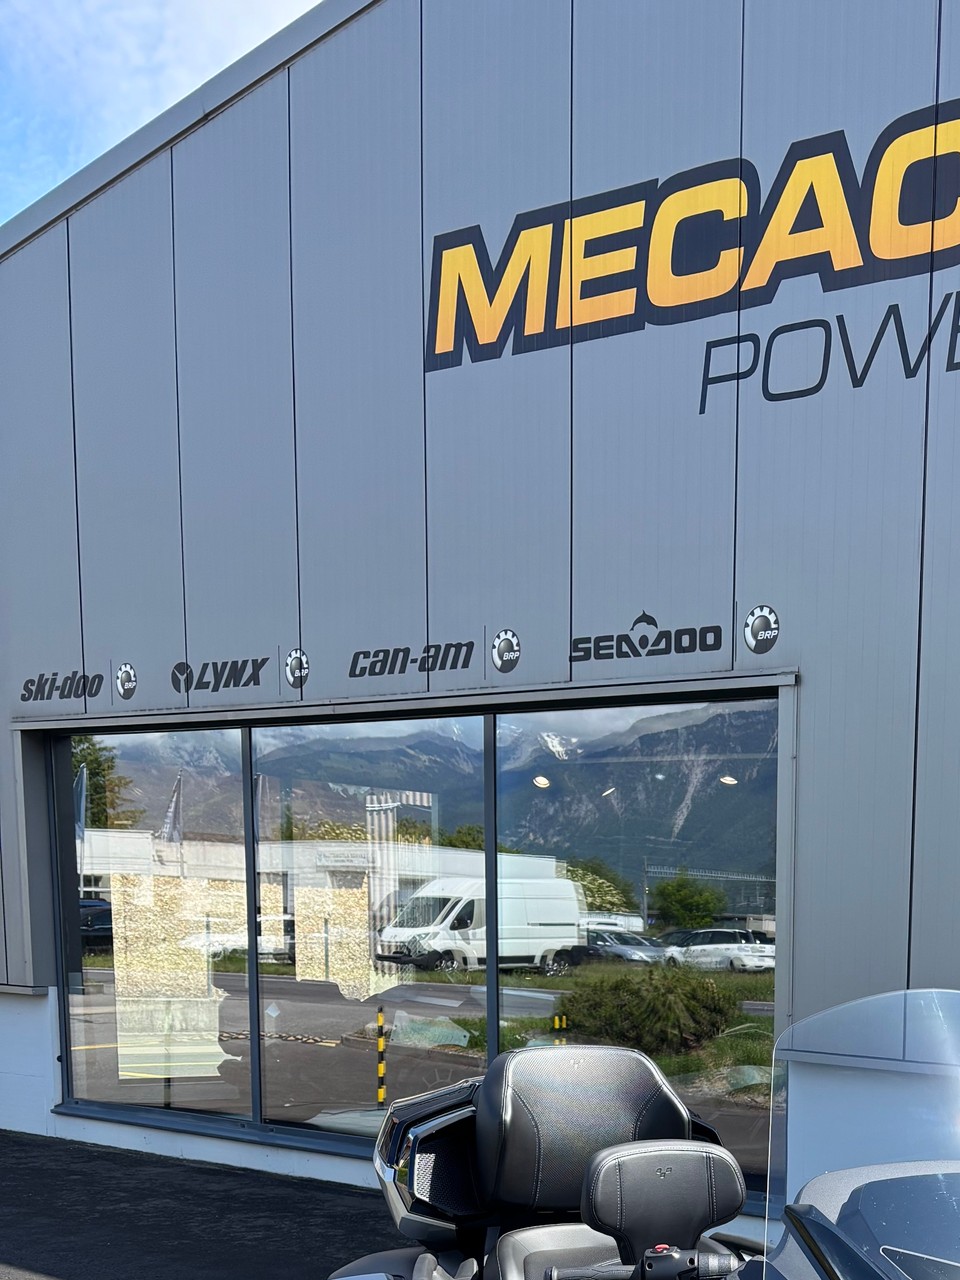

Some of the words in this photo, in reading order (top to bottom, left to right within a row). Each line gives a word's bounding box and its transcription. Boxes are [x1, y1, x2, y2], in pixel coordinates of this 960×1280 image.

[756, 629, 778, 640] BRP
[348, 640, 475, 679] can-am
[502, 651, 520, 661] BRP
[20, 669, 105, 702] ski-doo
[124, 681, 137, 689] BRP
[193, 656, 270, 693] LYNX
